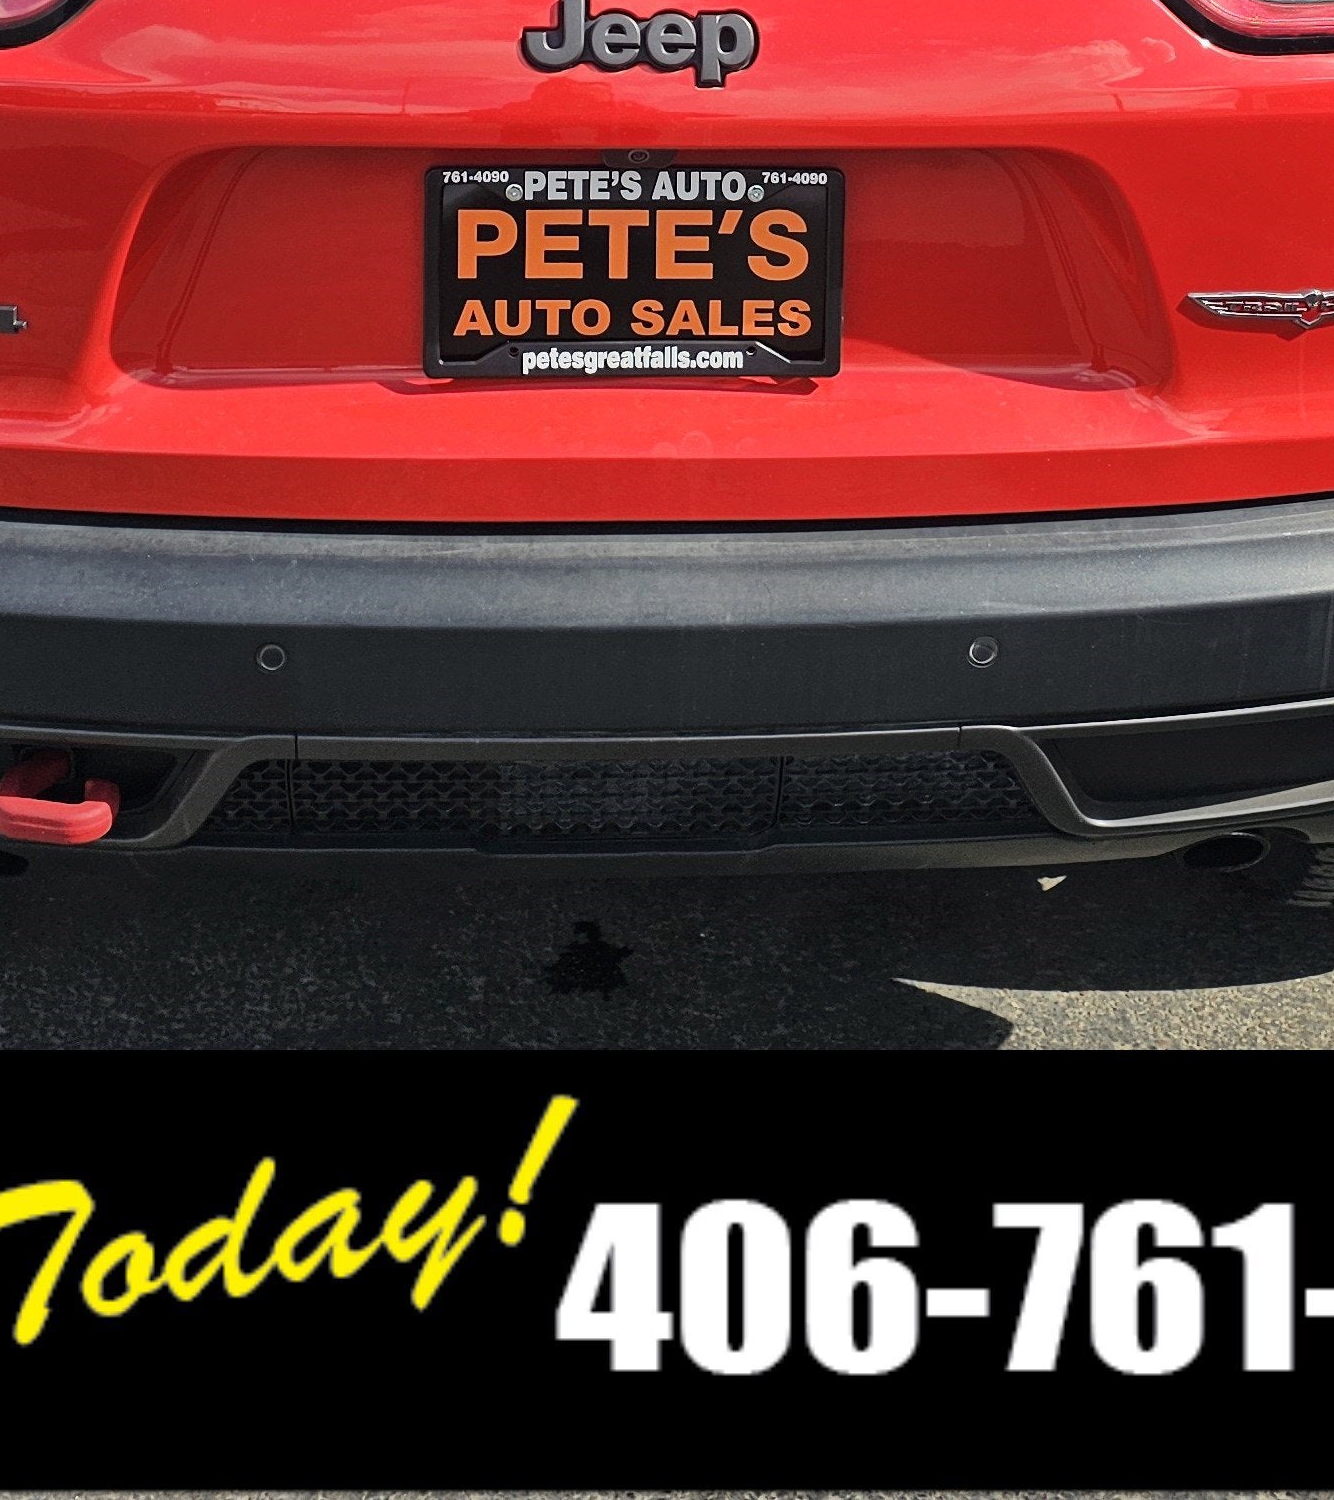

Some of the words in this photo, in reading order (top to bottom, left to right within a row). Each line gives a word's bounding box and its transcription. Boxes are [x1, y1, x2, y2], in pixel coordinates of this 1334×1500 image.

[442, 170, 509, 184] 761-4090
[524, 170, 642, 201] PETE'S
[651, 170, 747, 202] AUTO
[761, 171, 828, 185] 761-4090
[457, 209, 809, 281] PETE'S
[453, 299, 611, 336] AUTO
[630, 299, 812, 337] SALES
[522, 346, 744, 375] petesgreatfalls.com
